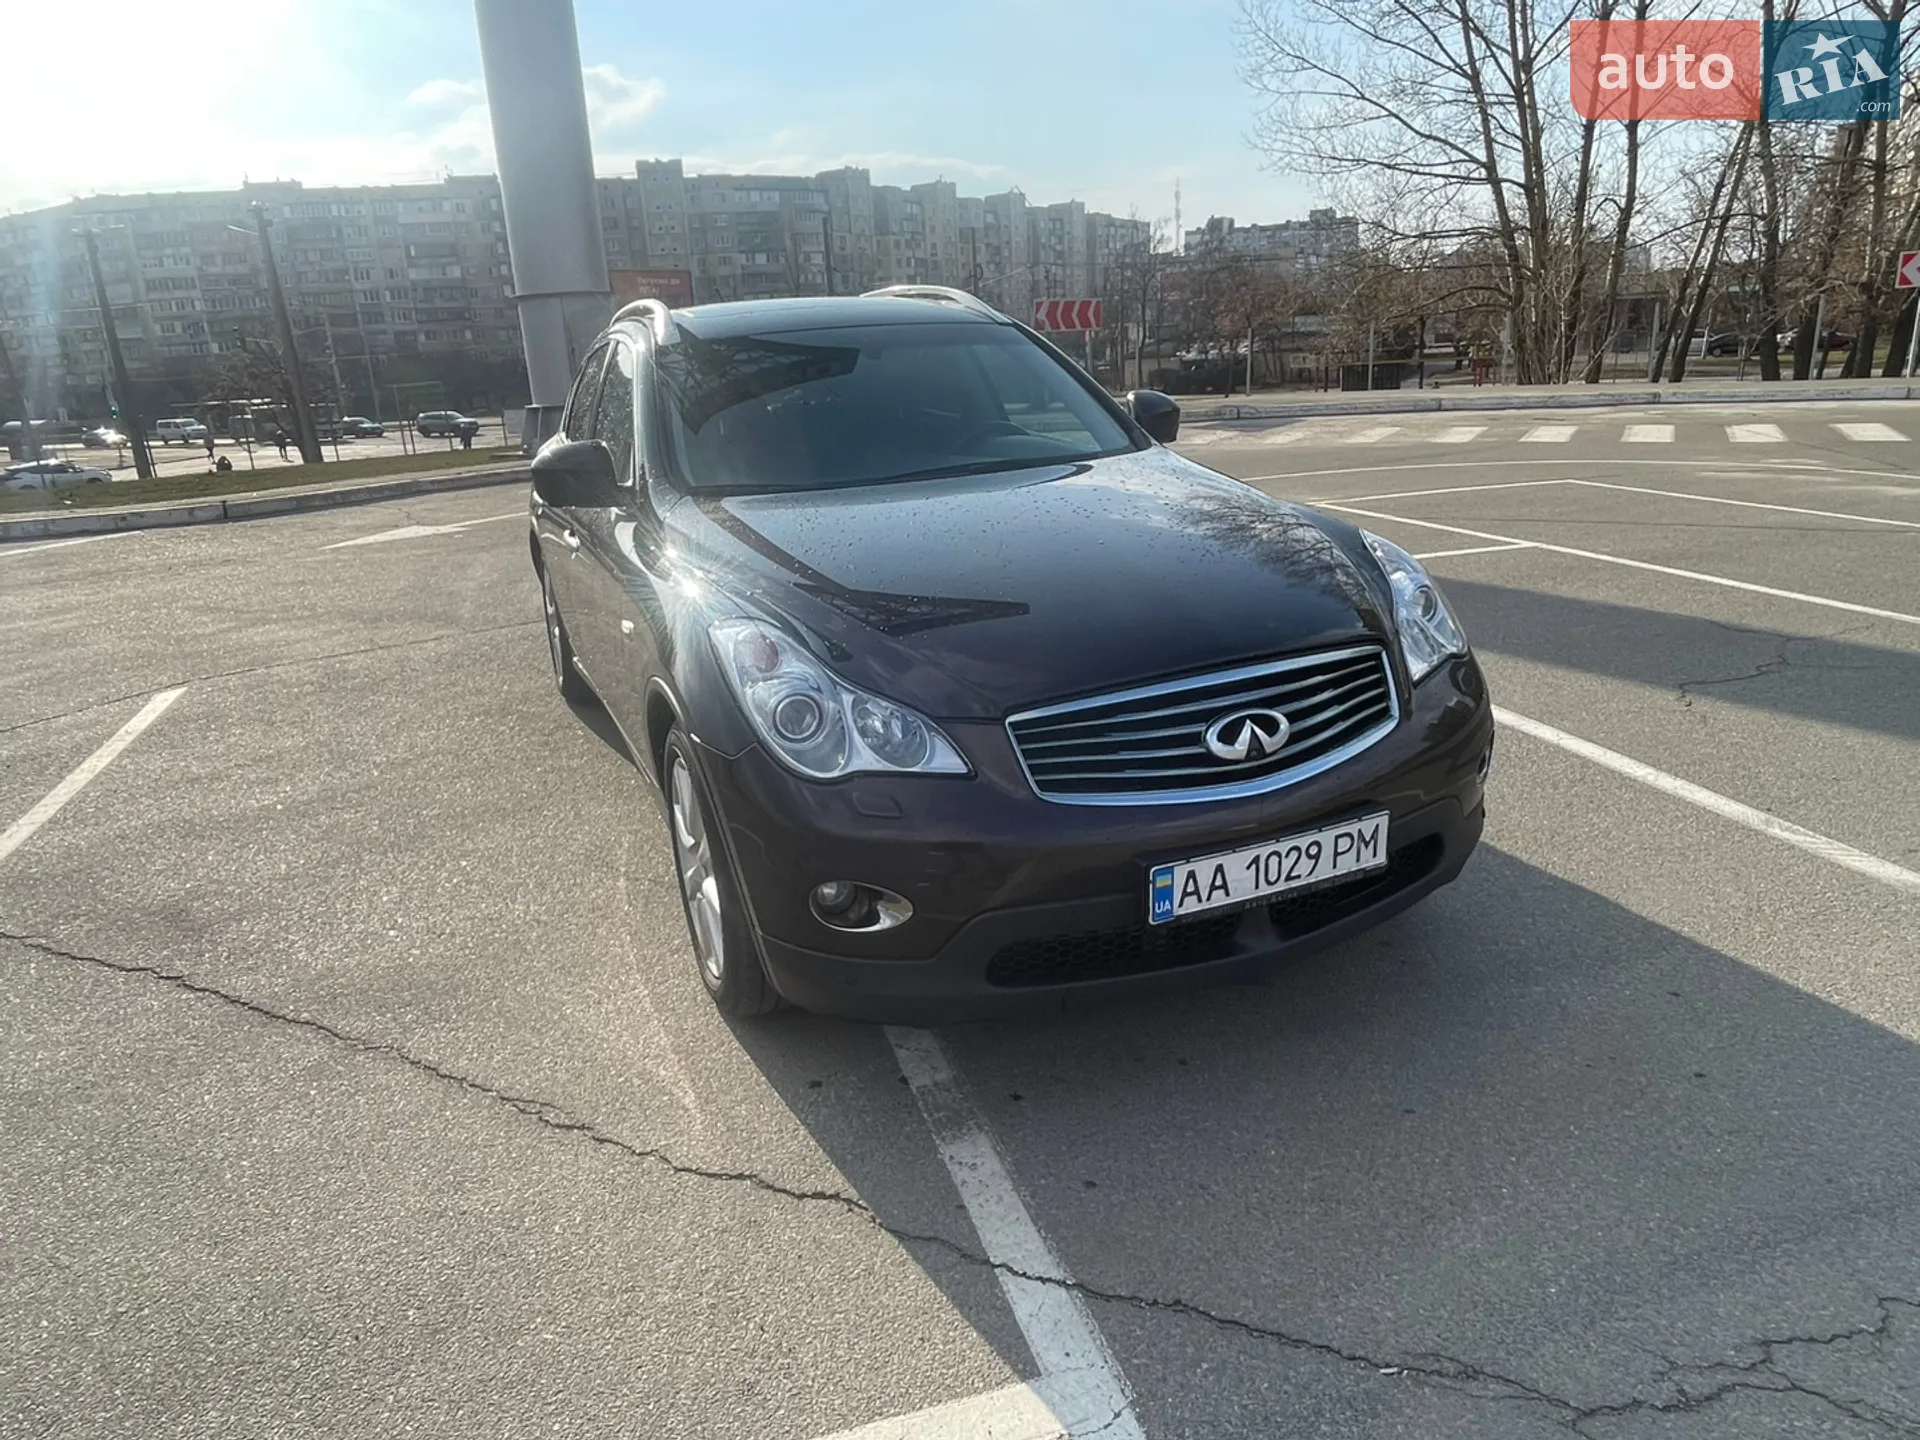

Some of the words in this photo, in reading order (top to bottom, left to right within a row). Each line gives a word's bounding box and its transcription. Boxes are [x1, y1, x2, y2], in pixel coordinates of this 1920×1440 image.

[1177, 863, 1231, 908] AA
[1245, 839, 1323, 891] 1029
[1331, 823, 1380, 870] PM
[1154, 899, 1172, 914] UA
